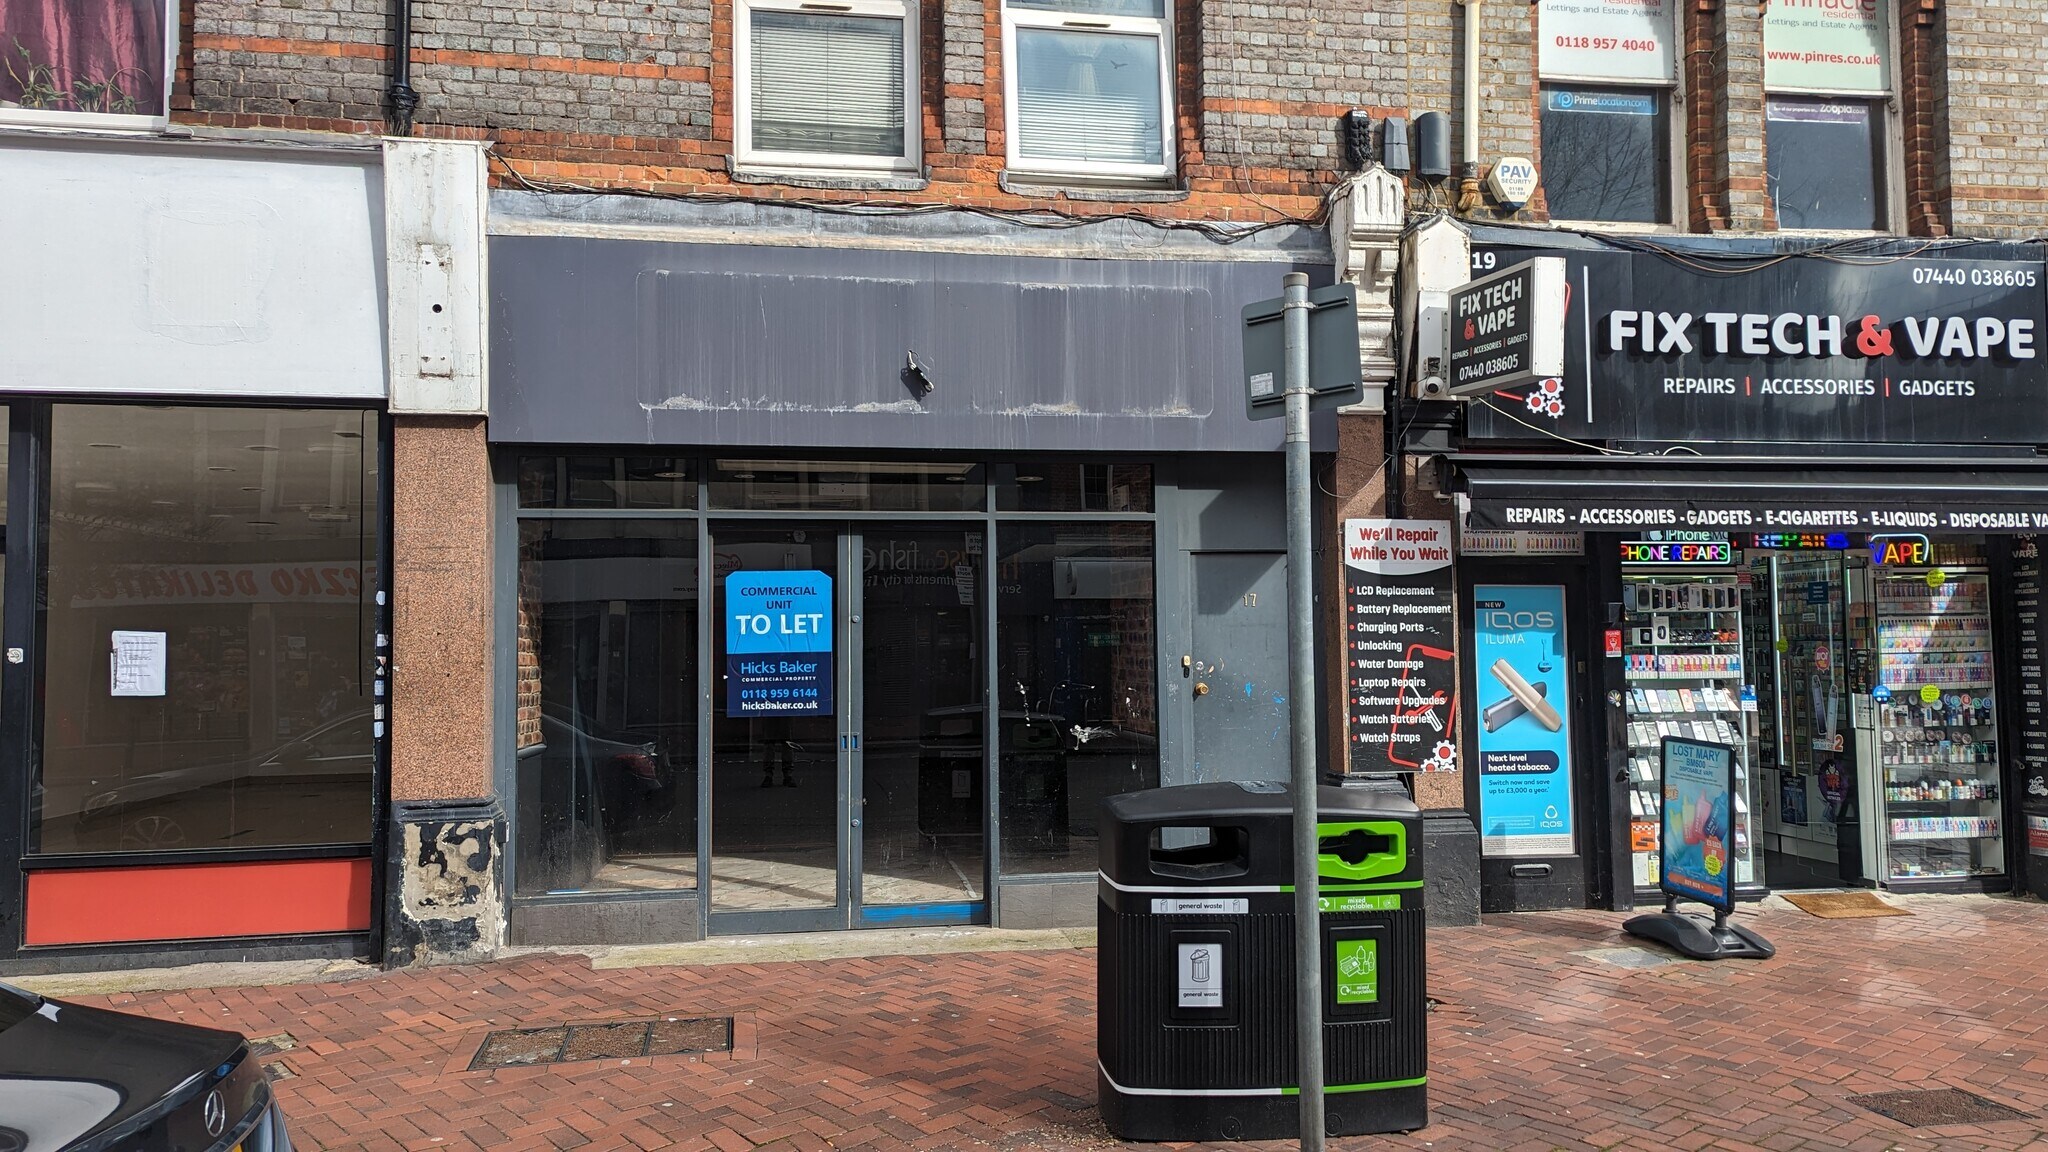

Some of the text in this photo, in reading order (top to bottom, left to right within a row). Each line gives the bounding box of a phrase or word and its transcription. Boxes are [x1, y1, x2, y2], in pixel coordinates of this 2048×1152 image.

[1546, 4, 1580, 13] Lettings
[1602, 7, 1629, 15] Estate
[1631, 8, 1662, 17] Agents
[1822, 10, 1876, 20] residential
[1767, 18, 1799, 28] Lettings
[1821, 21, 1846, 29] Estate
[1848, 22, 1877, 30] Agents
[1556, 36, 1654, 51] 0118 957 4040
[1767, 51, 1880, 65] www.pinres.co.uk
[1574, 95, 1649, 107] PrimeLocation.com
[1501, 165, 1531, 178] PAV
[1472, 252, 1496, 269] 19
[1912, 267, 2036, 288] 07440 038605
[1460, 277, 1522, 317] FIX TECH
[1464, 305, 1516, 340] & VAPE
[1610, 310, 2036, 359] FIX TECH & VAPE
[1452, 332, 1528, 360] REPAIRS ACCESSORIES GADGETS
[1459, 353, 1518, 381] 07440 038605
[1663, 377, 1976, 397] REPAIRS ACCESSORIES GADGETS
[1506, 508, 1565, 523] REPAIRS
[1580, 509, 1676, 524] ACCESSORIES
[1687, 510, 1751, 526] GADGETS
[1765, 510, 1858, 526] E-CIGARETTES
[1871, 511, 1938, 528] E-LIQUIDS
[1949, 512, 2029, 528] DISPOSABLE
[1359, 527, 1438, 544] We'll Repair
[1350, 547, 1449, 560] While You Wait
[1672, 545, 1728, 561] REPAIRS
[1869, 542, 1923, 565] VAPE
[740, 587, 817, 596] COMMERCIAL
[1357, 585, 1435, 597] LCD Replacement
[766, 600, 792, 610] UNIT
[1243, 593, 1257, 607] 17
[1357, 604, 1452, 615] Battery Replacement
[735, 614, 823, 635] TO LET
[1485, 611, 1554, 630] IQOS
[1357, 622, 1425, 634] Charging Ports
[1485, 634, 1525, 644] ILUMA
[1358, 640, 1402, 652] Unlocking
[741, 660, 817, 674] Hicks Baker
[1358, 660, 1424, 670] Water Damage
[1359, 677, 1426, 689] Laptop Repairs
[742, 688, 818, 699] 0118 959 6144
[742, 700, 818, 710] hicksbaker.co.uk
[1359, 696, 1446, 707] Software Upgrades
[1359, 714, 1431, 724] Watch Batteries
[1360, 733, 1420, 744] Watch Straps
[1488, 754, 1527, 762] Next level
[1672, 744, 1720, 762] LOST MARY
[1488, 763, 1551, 772] heated tobacco.
[1178, 902, 1222, 910] general waste
[1340, 902, 1374, 910] recyclables
